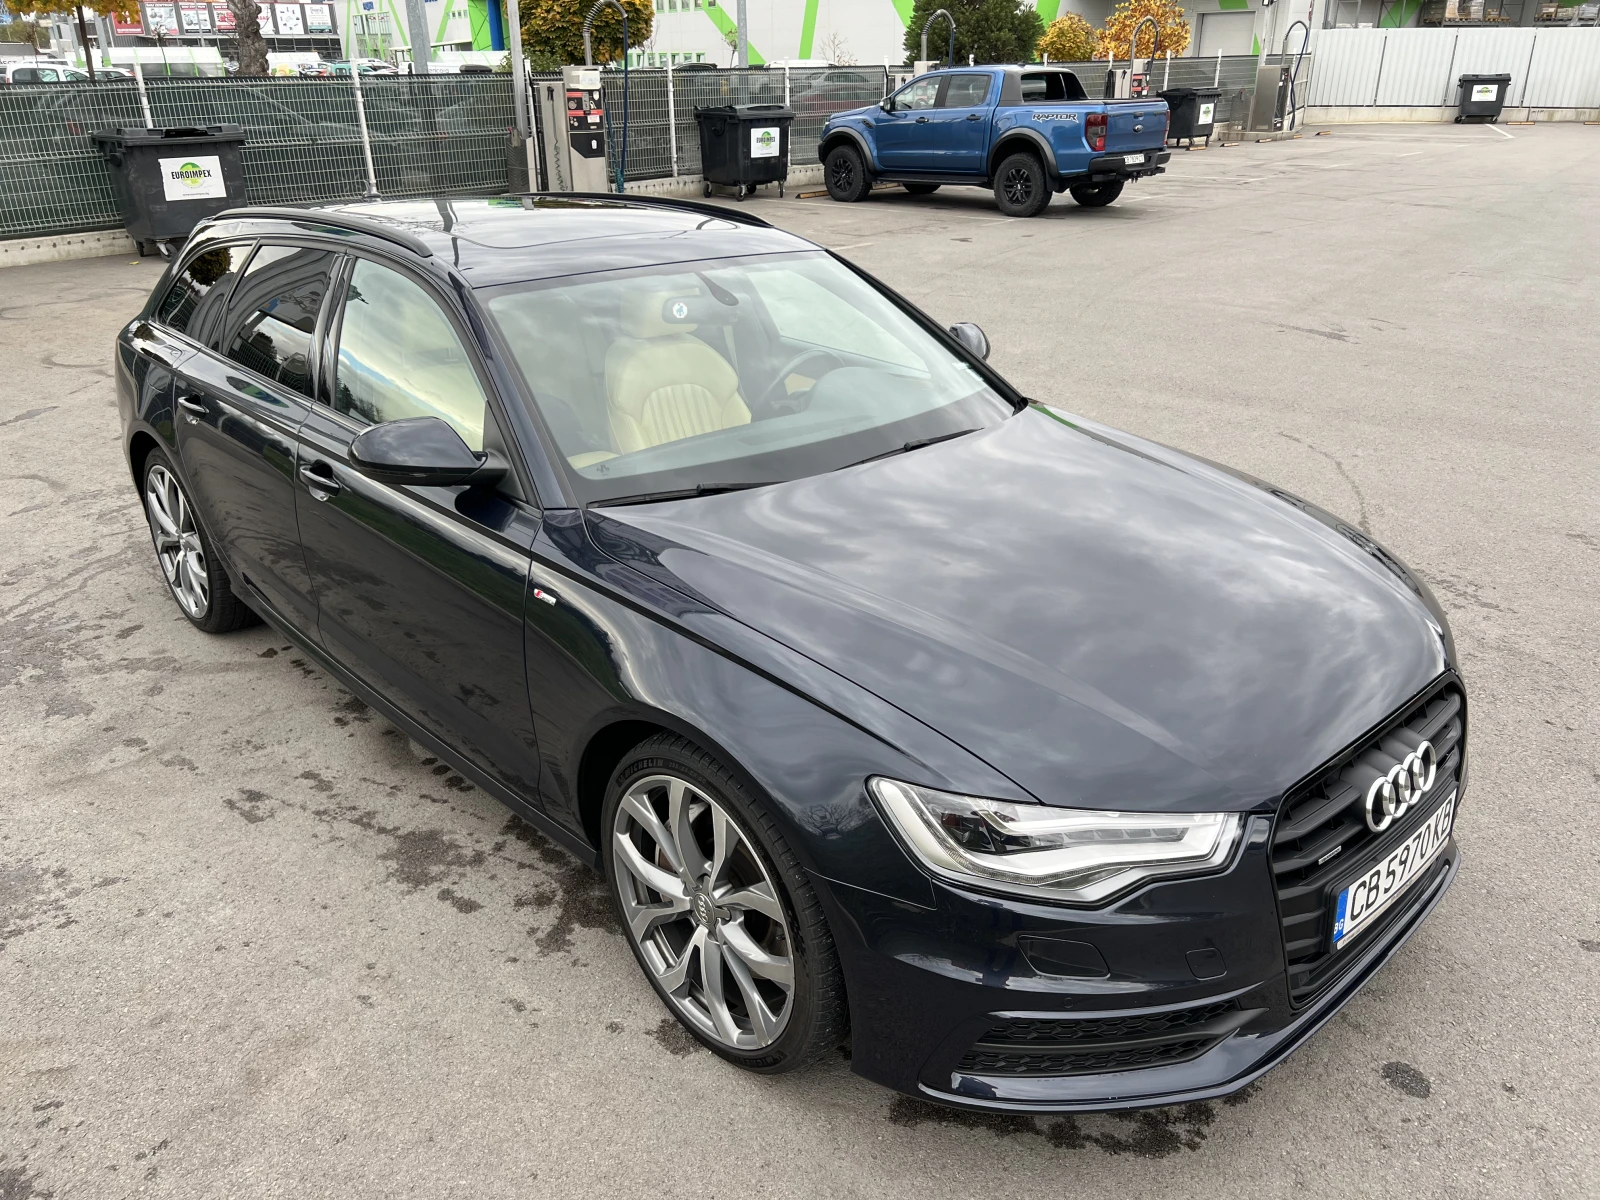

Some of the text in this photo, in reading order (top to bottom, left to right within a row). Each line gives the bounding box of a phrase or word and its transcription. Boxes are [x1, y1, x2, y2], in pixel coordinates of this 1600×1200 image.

[1032, 113, 1078, 123] RAPTOR
[171, 169, 212, 180] EUROIMPEX
[625, 758, 664, 779] MICHELIN
[1334, 918, 1344, 934] BG
